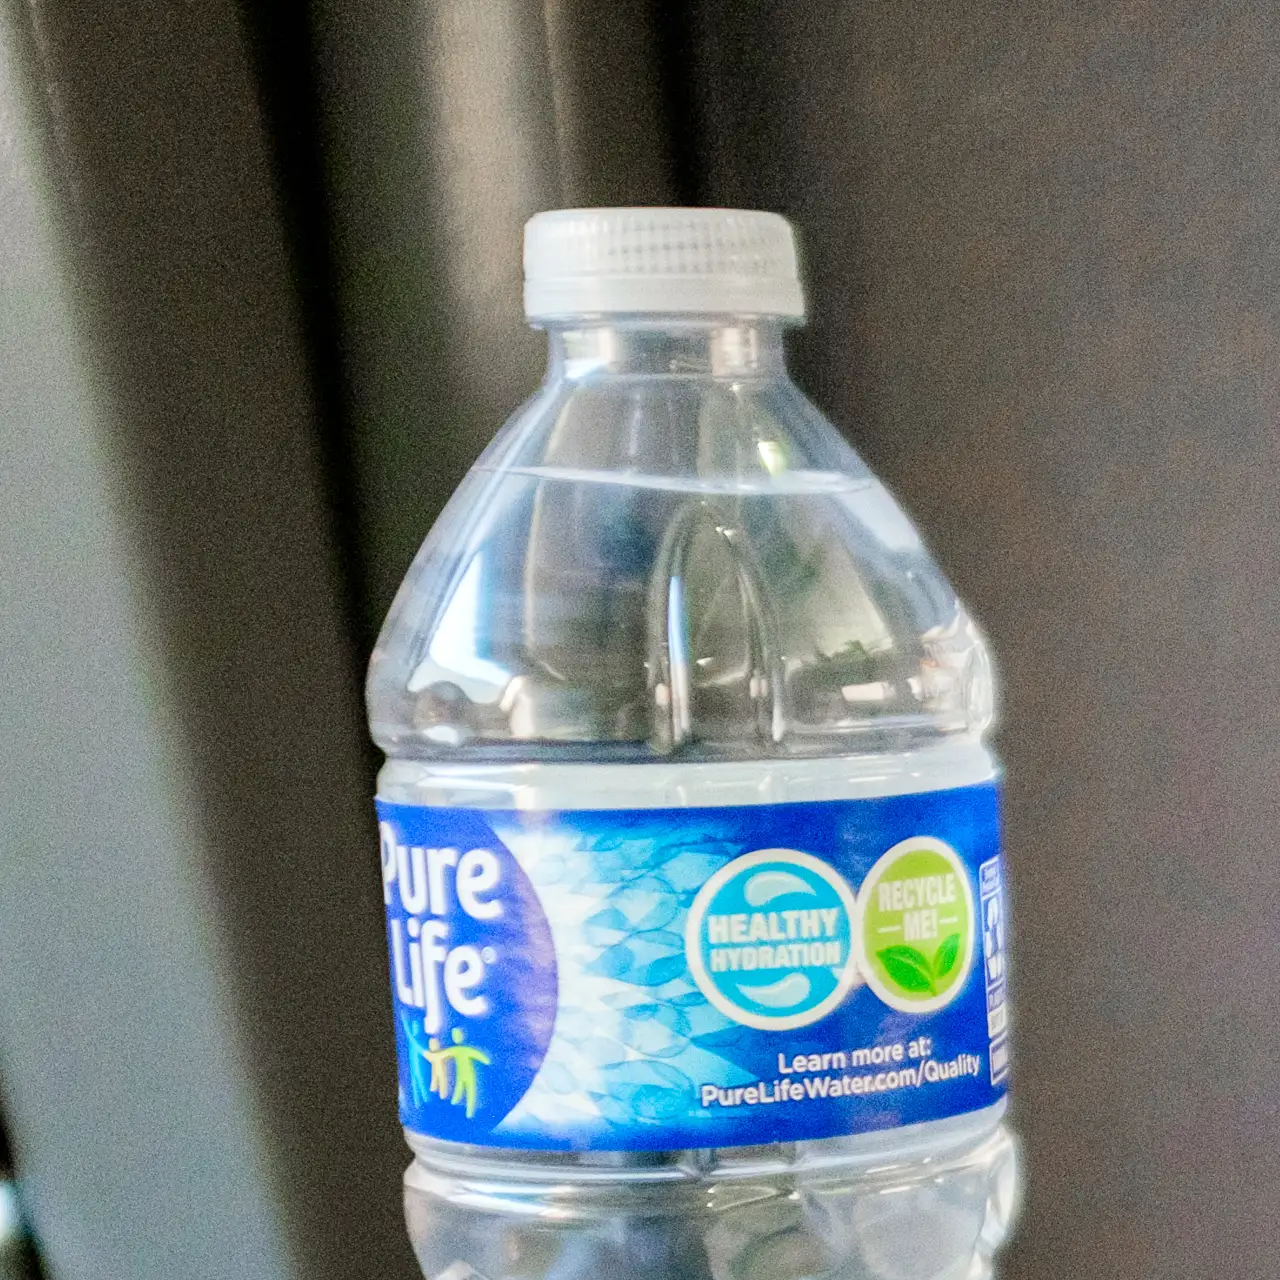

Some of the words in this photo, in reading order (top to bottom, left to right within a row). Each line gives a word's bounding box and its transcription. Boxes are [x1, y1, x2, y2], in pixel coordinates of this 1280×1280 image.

[379, 821, 503, 919] Pure
[878, 873, 957, 912] RECYCLE
[708, 907, 840, 944] HEALTHY
[903, 908, 938, 942] ME!
[711, 941, 842, 973] HYDRATION
[778, 1051, 846, 1075] Learn
[852, 1044, 901, 1068] more
[908, 1035, 932, 1057] at:
[701, 1053, 981, 1108] PureLifeWater.com/Quality
